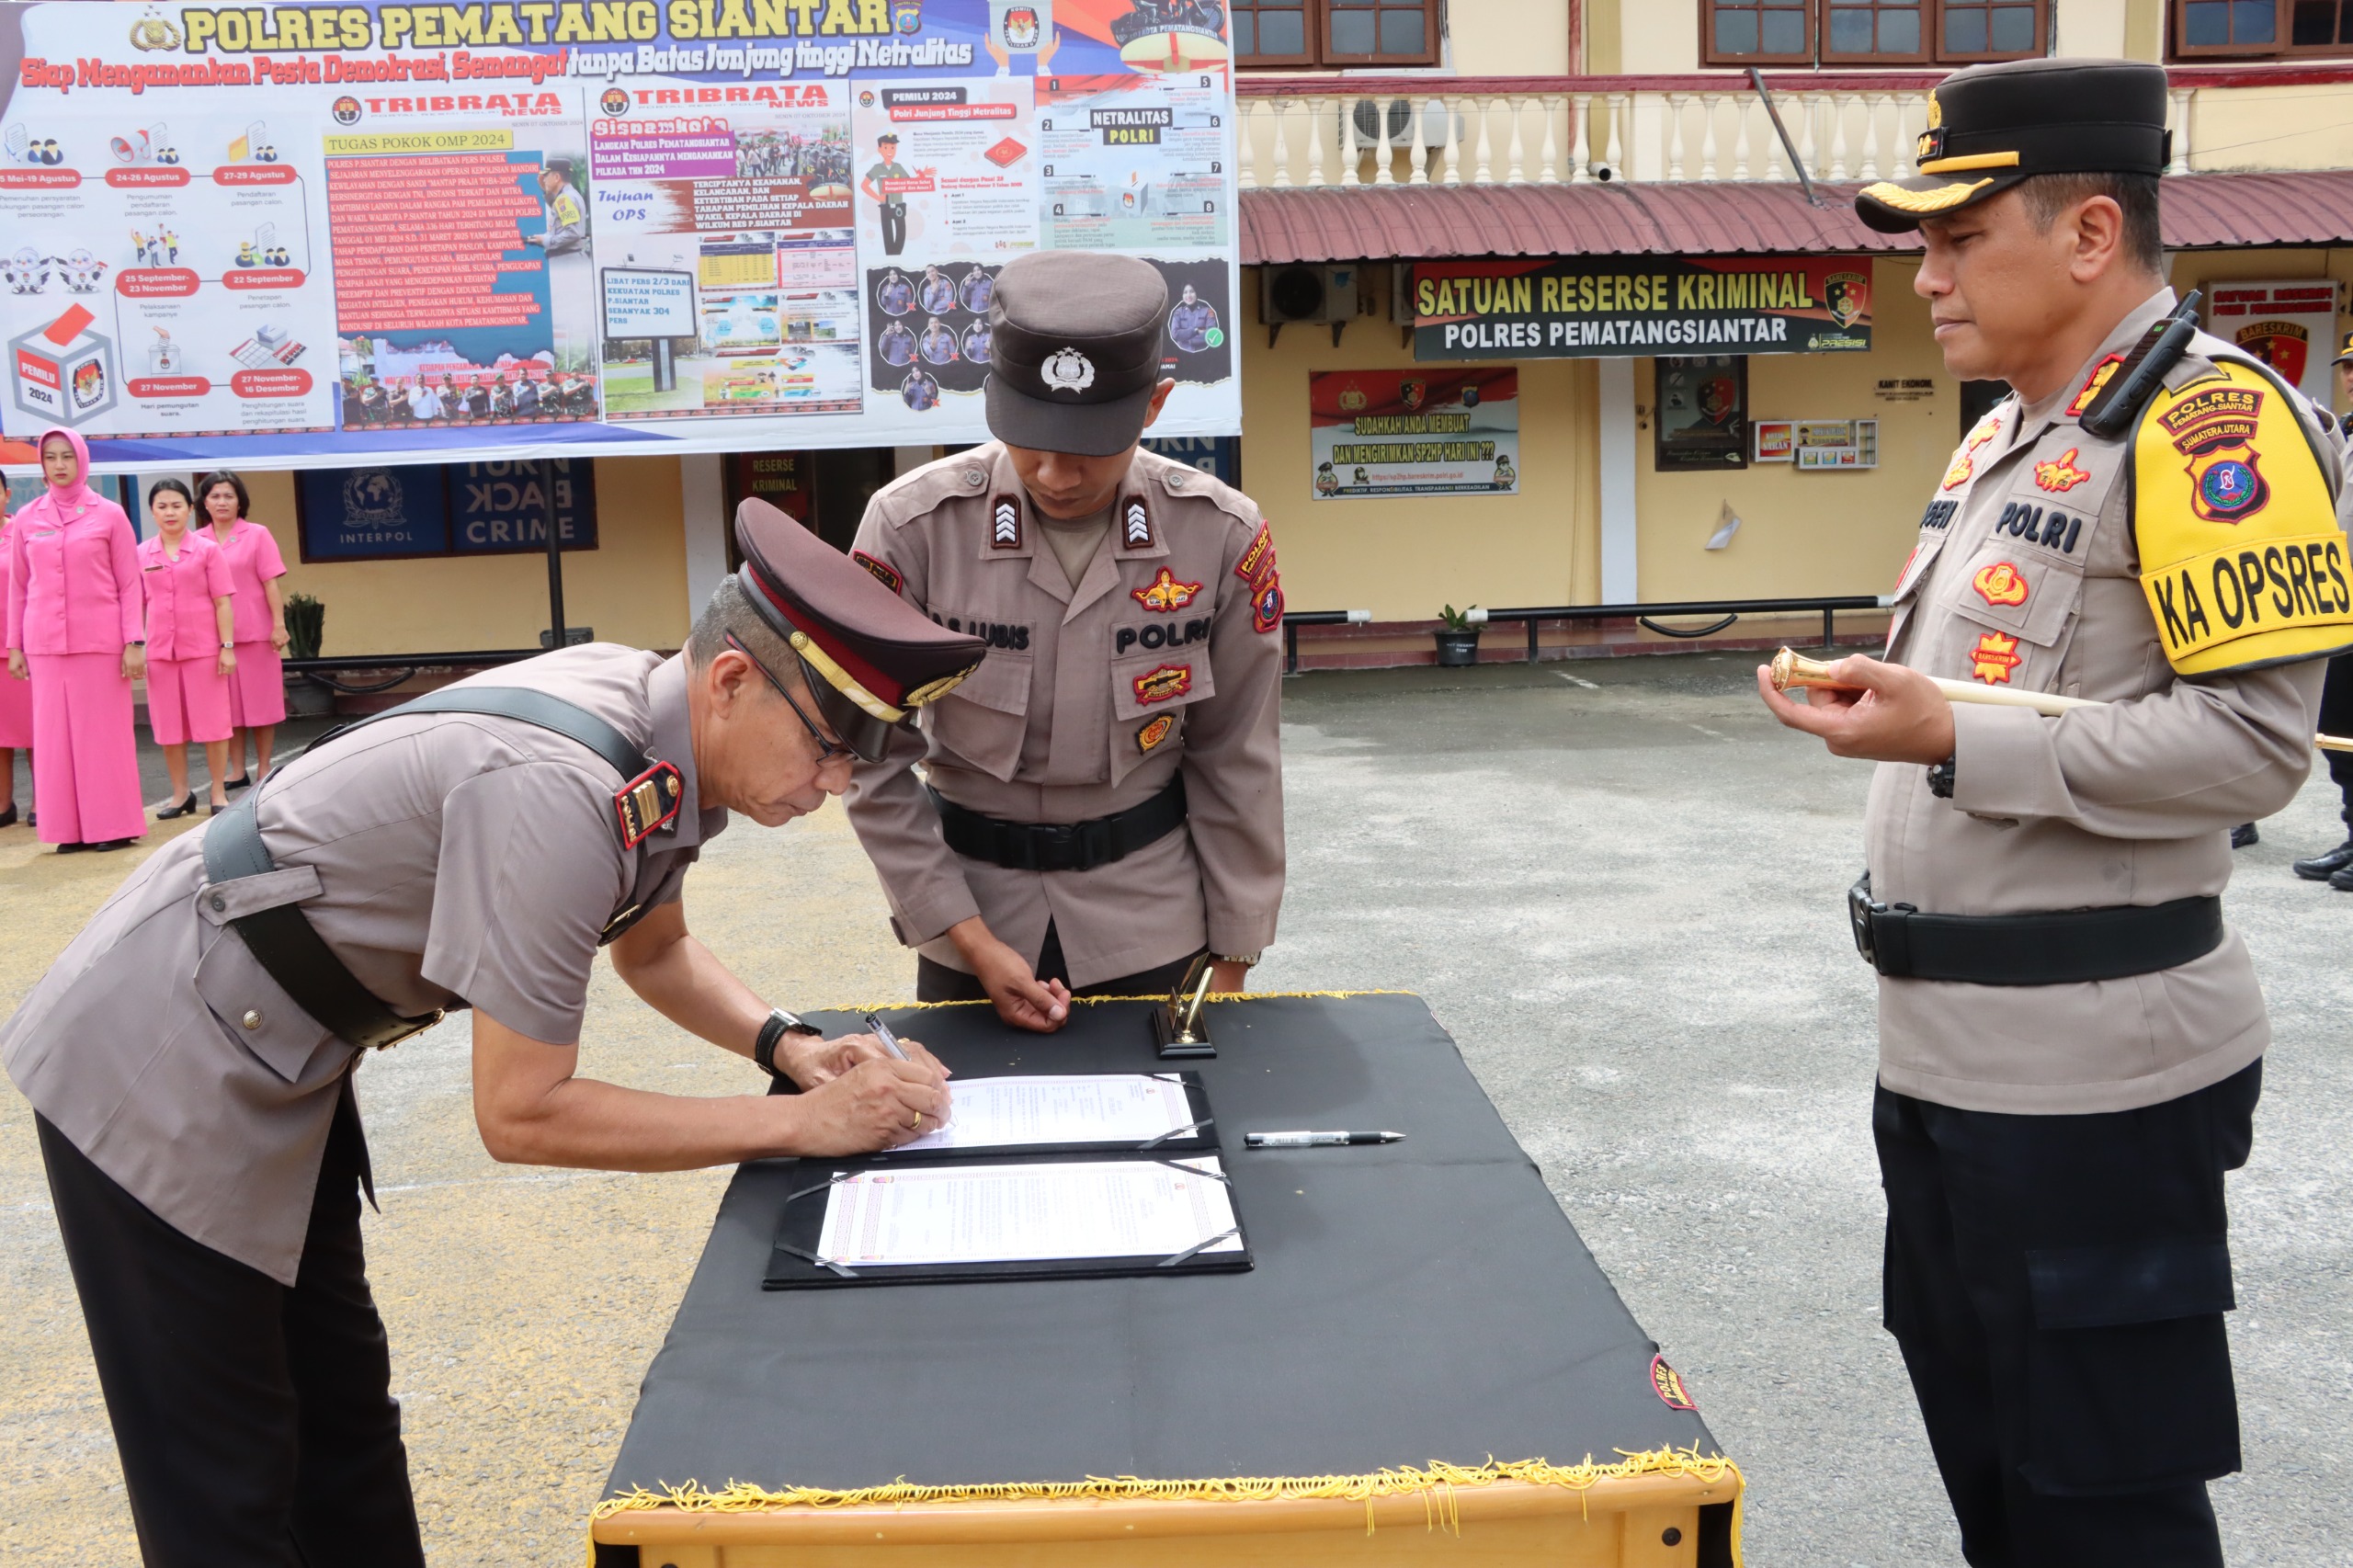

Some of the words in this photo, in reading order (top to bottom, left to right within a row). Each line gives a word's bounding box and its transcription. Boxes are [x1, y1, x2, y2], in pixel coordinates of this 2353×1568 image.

[183, 8, 371, 53] POLRES
[381, 1, 656, 49] PEMATANG
[668, 0, 895, 40] SIANTAR
[1142, 26, 1158, 36] KOTA
[1160, 24, 1218, 38] PEMATANGSIANTAR
[20, 58, 75, 94] Siap
[77, 55, 250, 94] Mengamankan
[251, 55, 320, 84] Pesta
[324, 51, 449, 84] Demokrasi,
[451, 50, 568, 83] Semangat
[571, 46, 634, 80] tanpa
[639, 41, 704, 73] Batas
[705, 42, 794, 78] Junjung
[796, 40, 857, 77] tinggi
[858, 39, 972, 70] Netralitas
[632, 85, 828, 105] TRIBRATA
[892, 92, 930, 102] PEMILU
[931, 91, 957, 101] 2024
[364, 92, 562, 113] TRIBRATA
[768, 100, 828, 108] NEWS
[501, 107, 562, 117] NEWS
[893, 108, 912, 119] Polri
[914, 108, 946, 119] Junjung
[948, 108, 971, 118] Tinggi
[972, 107, 1011, 116] Netralitas
[1093, 111, 1169, 125] NETRALITAS
[329, 138, 377, 150] TUGAS
[381, 136, 431, 149] POKOK
[436, 135, 467, 147] OMP
[472, 133, 506, 145] 2024
[1109, 130, 1154, 143] POLRI
[327, 160, 353, 169] POLRES
[354, 159, 388, 168] P.SIANTAR
[389, 158, 416, 166] DENGAN
[417, 156, 460, 165] MELIBATKAN
[461, 155, 479, 165] PERS
[480, 154, 506, 164] POLSEK
[223, 171, 247, 181] 27-29
[249, 170, 286, 182] Agustus
[644, 165, 665, 175] 2024
[7, 175, 38, 183] Mei-19
[40, 174, 76, 185] Agustus
[116, 174, 141, 183] 24-26
[143, 173, 180, 184] Agustus
[693, 179, 752, 189] TERCIPTANYA
[597, 189, 654, 204] Tujuan
[751, 187, 770, 196] DAN
[693, 196, 745, 205] KETERTIBAN
[745, 195, 768, 204] PADA
[770, 194, 799, 203] SETIAP
[694, 205, 735, 214] TAHAPAN
[736, 203, 779, 212] PEMILIHAN
[781, 202, 815, 211] KEPALA
[816, 200, 848, 210] DAERAH
[611, 208, 646, 222] OPS
[695, 212, 724, 222] WAKIL
[725, 211, 760, 221] KEPALA
[761, 210, 793, 220] DAERAH
[793, 210, 801, 218] DI
[695, 221, 732, 230] WILKUM
[733, 221, 751, 229] RES
[752, 219, 792, 229] P.SIANTAR
[125, 274, 137, 283] 25
[138, 273, 190, 284] September-
[233, 276, 244, 285] 22
[246, 274, 294, 286] September
[653, 277, 669, 287] 2/3
[130, 284, 141, 292] 23
[142, 283, 188, 292] November
[607, 288, 651, 296] KEKUATAN
[1417, 277, 1532, 315] SATUAN
[1542, 274, 1668, 313] RESERSE
[1677, 272, 1813, 312] KRIMINAL
[608, 297, 649, 305] P.SIANTAR
[608, 307, 652, 315] SEBANYAK
[654, 306, 670, 316] 304
[1444, 321, 1542, 349] POLRES
[1549, 317, 1788, 347] PEMATANGSIANTAR
[2240, 323, 2304, 340] BARESKRIM
[1821, 338, 1867, 347] PRESISI
[21, 363, 56, 385] PEMILU
[242, 376, 253, 384] 27
[254, 374, 301, 384] November-
[141, 383, 153, 392] 27
[153, 382, 198, 392] November
[244, 386, 255, 394] 16
[256, 384, 300, 393] Desember
[1879, 380, 1900, 389] KANIT
[28, 386, 53, 405] 2024
[2167, 392, 2255, 424] POLRES
[1354, 415, 1402, 436] SUDAHKAH
[1403, 415, 1427, 435] ANDA
[1428, 414, 1470, 434] MEMBUAT
[2182, 426, 2223, 451] SUMATERA
[2223, 424, 2251, 435] UTARA
[1333, 444, 1351, 464] DAN
[1352, 443, 1415, 463] MENGIRIMKAN
[1415, 442, 1443, 462] SP2HP
[1444, 441, 1465, 461] HARI
[1466, 441, 1480, 461] INI
[1481, 441, 1495, 460] ???
[753, 459, 795, 472] RESERSE
[752, 478, 797, 493] KRIMINAL
[1455, 483, 1490, 492] BERKEADILAN
[466, 517, 574, 544] CRIME
[1995, 501, 2082, 554] POLRI
[340, 531, 413, 544] INTERPOL
[2154, 568, 2211, 650] KA
[2212, 540, 2350, 630] OPSRES
[1116, 616, 1211, 654] POLRI
